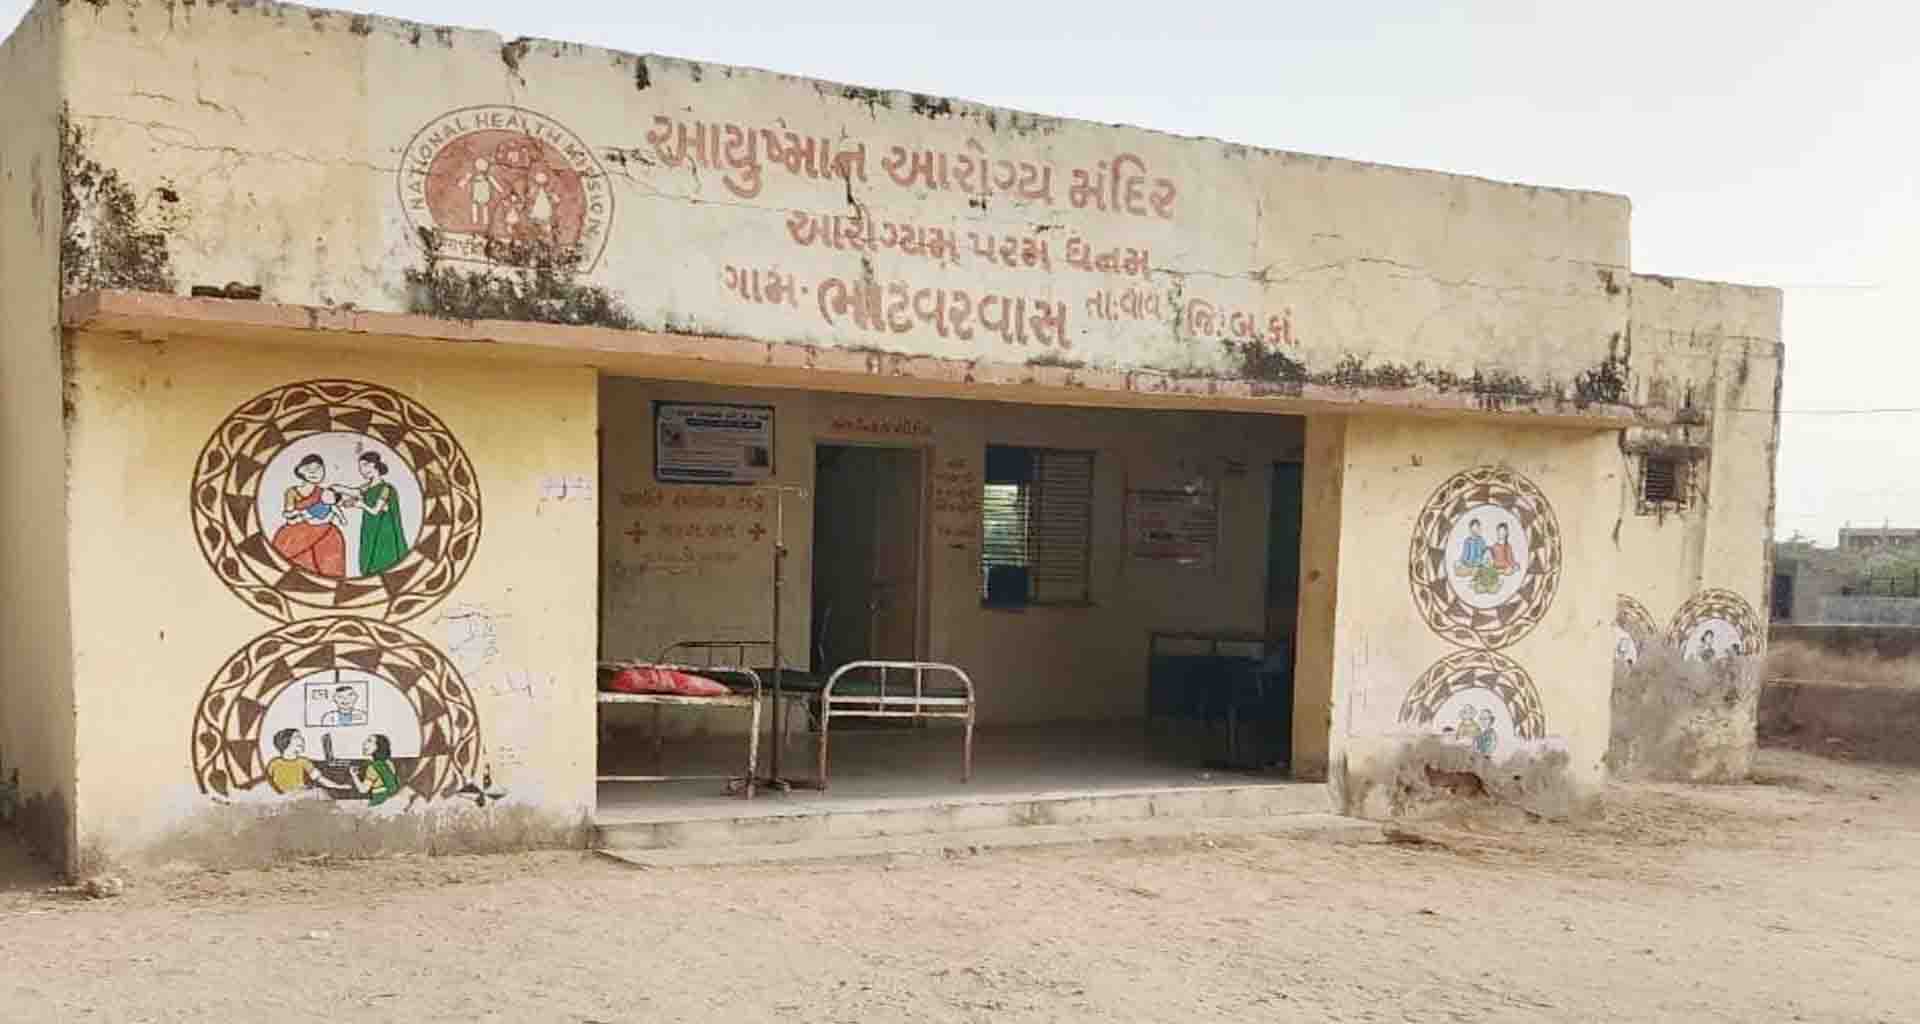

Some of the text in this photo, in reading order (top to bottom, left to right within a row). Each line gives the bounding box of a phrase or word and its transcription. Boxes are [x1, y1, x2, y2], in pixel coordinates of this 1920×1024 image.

[406, 116, 466, 211] NATIONAL
[475, 111, 565, 144] HEALTH
[881, 138, 1055, 207] આરોગ્ય
[1069, 152, 1178, 218] મંદિર
